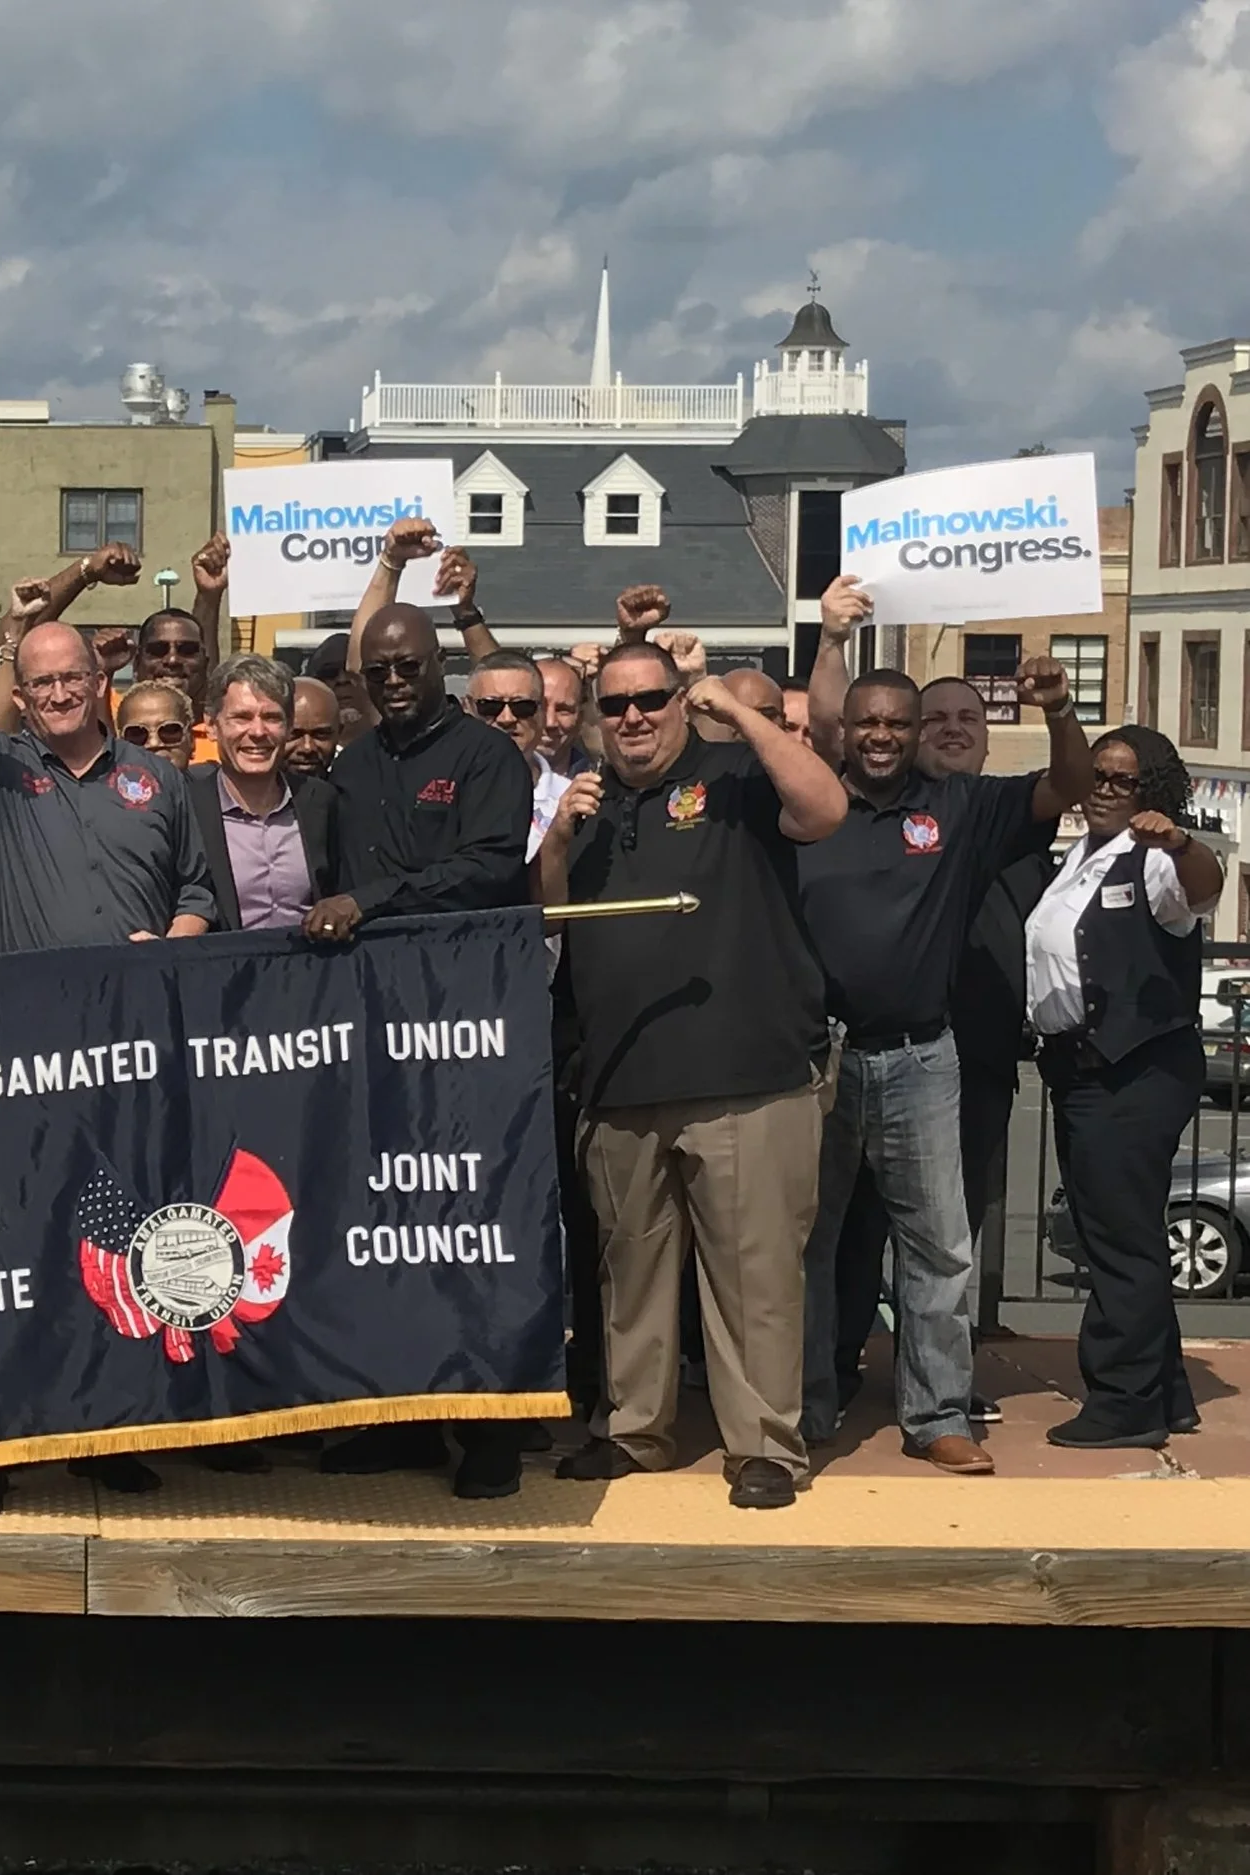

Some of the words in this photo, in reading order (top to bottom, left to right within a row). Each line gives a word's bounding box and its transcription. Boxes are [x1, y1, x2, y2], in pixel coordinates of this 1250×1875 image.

[846, 495, 1068, 552] Malinowski.
[899, 535, 1092, 574] Congress.
[188, 1022, 354, 1078] TRANSIT
[385, 1018, 506, 1061] UNION
[368, 1152, 482, 1192] JOINT
[133, 1206, 238, 1252] AMALGAMATED
[346, 1223, 516, 1267] COUNCIL
[136, 1282, 196, 1328] TRANSIT
[209, 1273, 244, 1320] UNION
